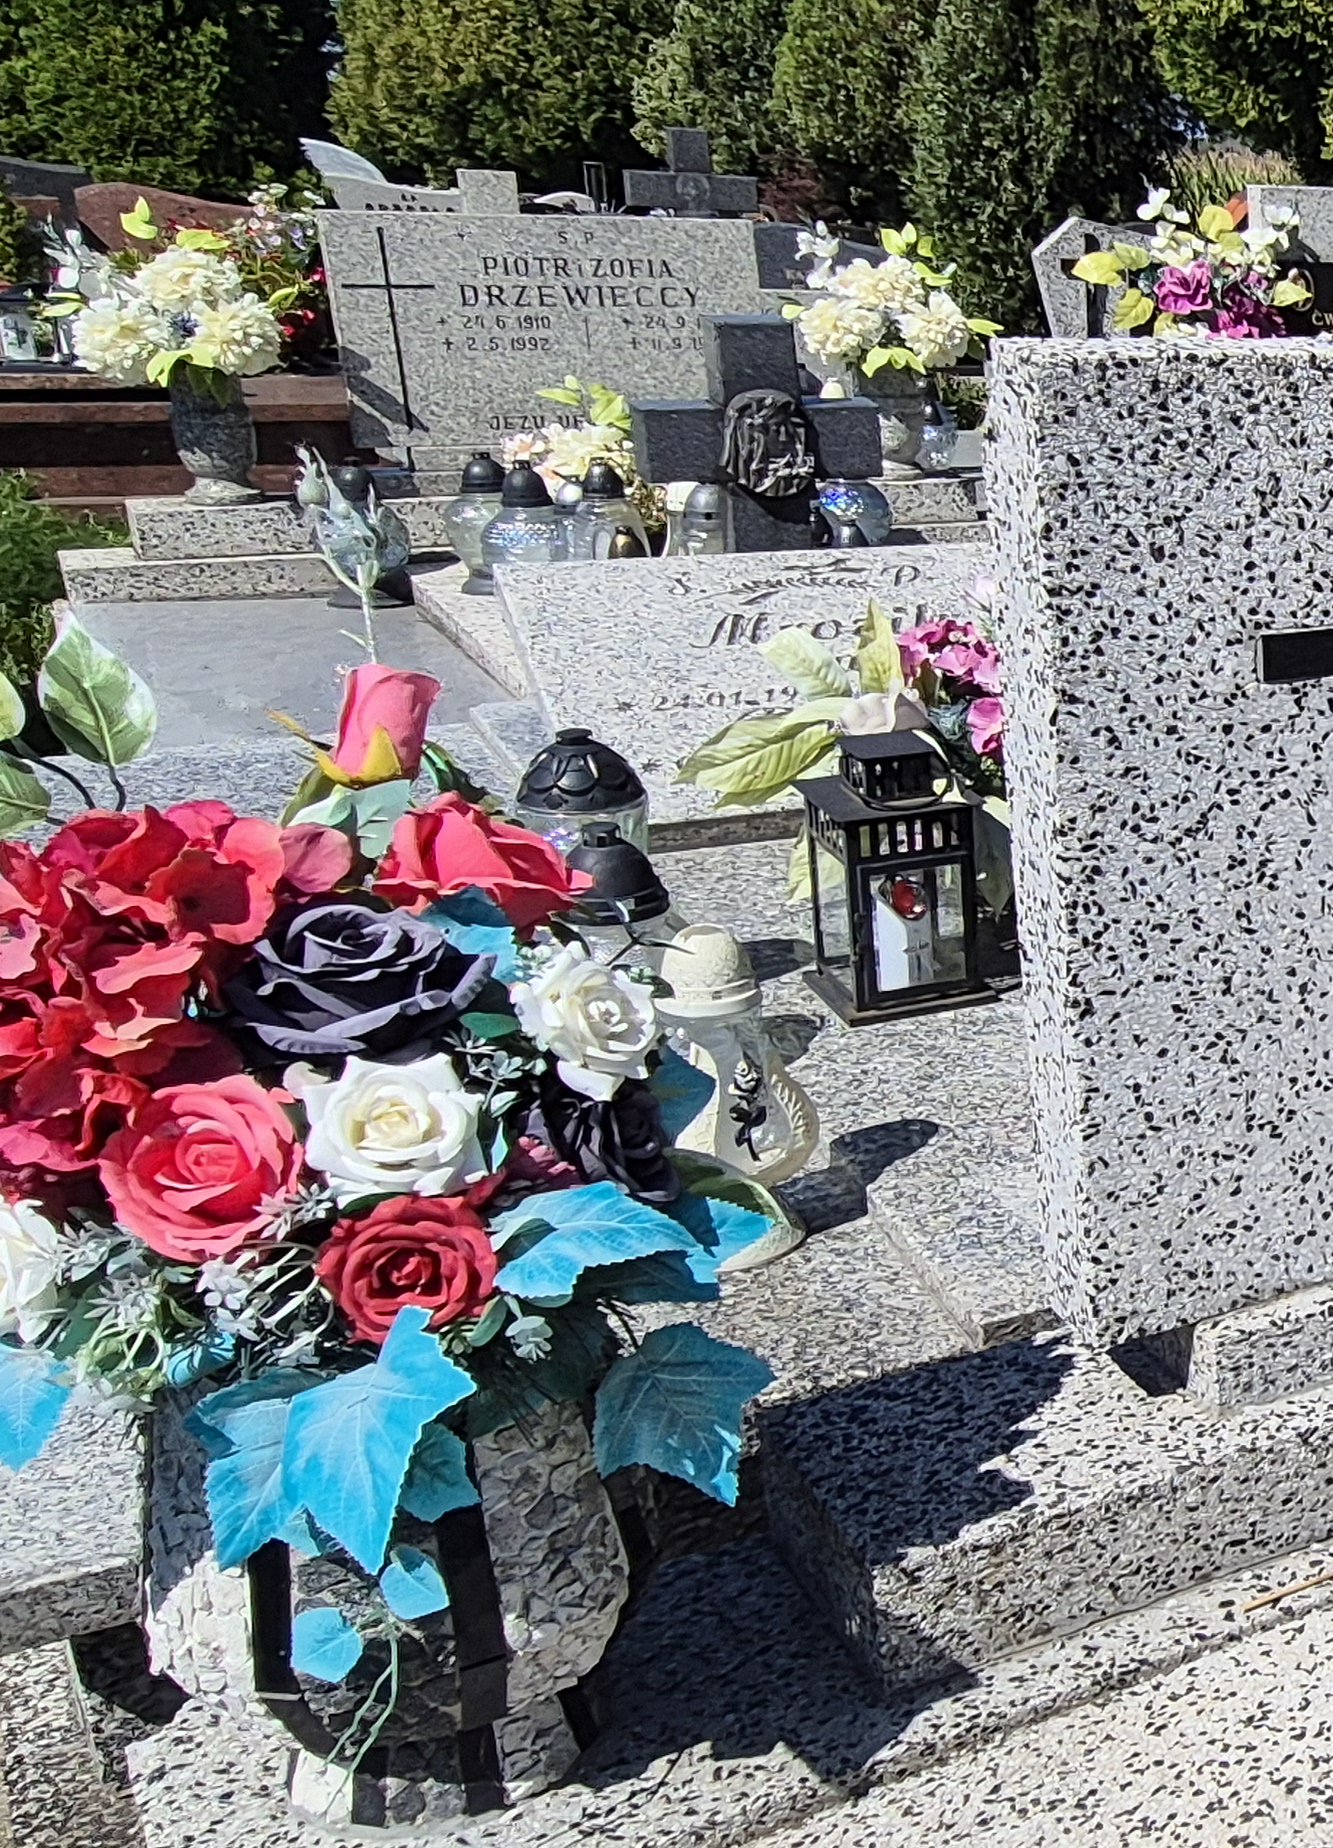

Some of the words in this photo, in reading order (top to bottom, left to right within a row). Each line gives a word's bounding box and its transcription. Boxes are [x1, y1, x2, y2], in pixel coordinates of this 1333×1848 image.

[481, 256, 571, 278] PIOTR
[590, 258, 675, 278] ZOFIA
[460, 284, 700, 308] DRZEWIECCY
[489, 415, 545, 431] JEZU
